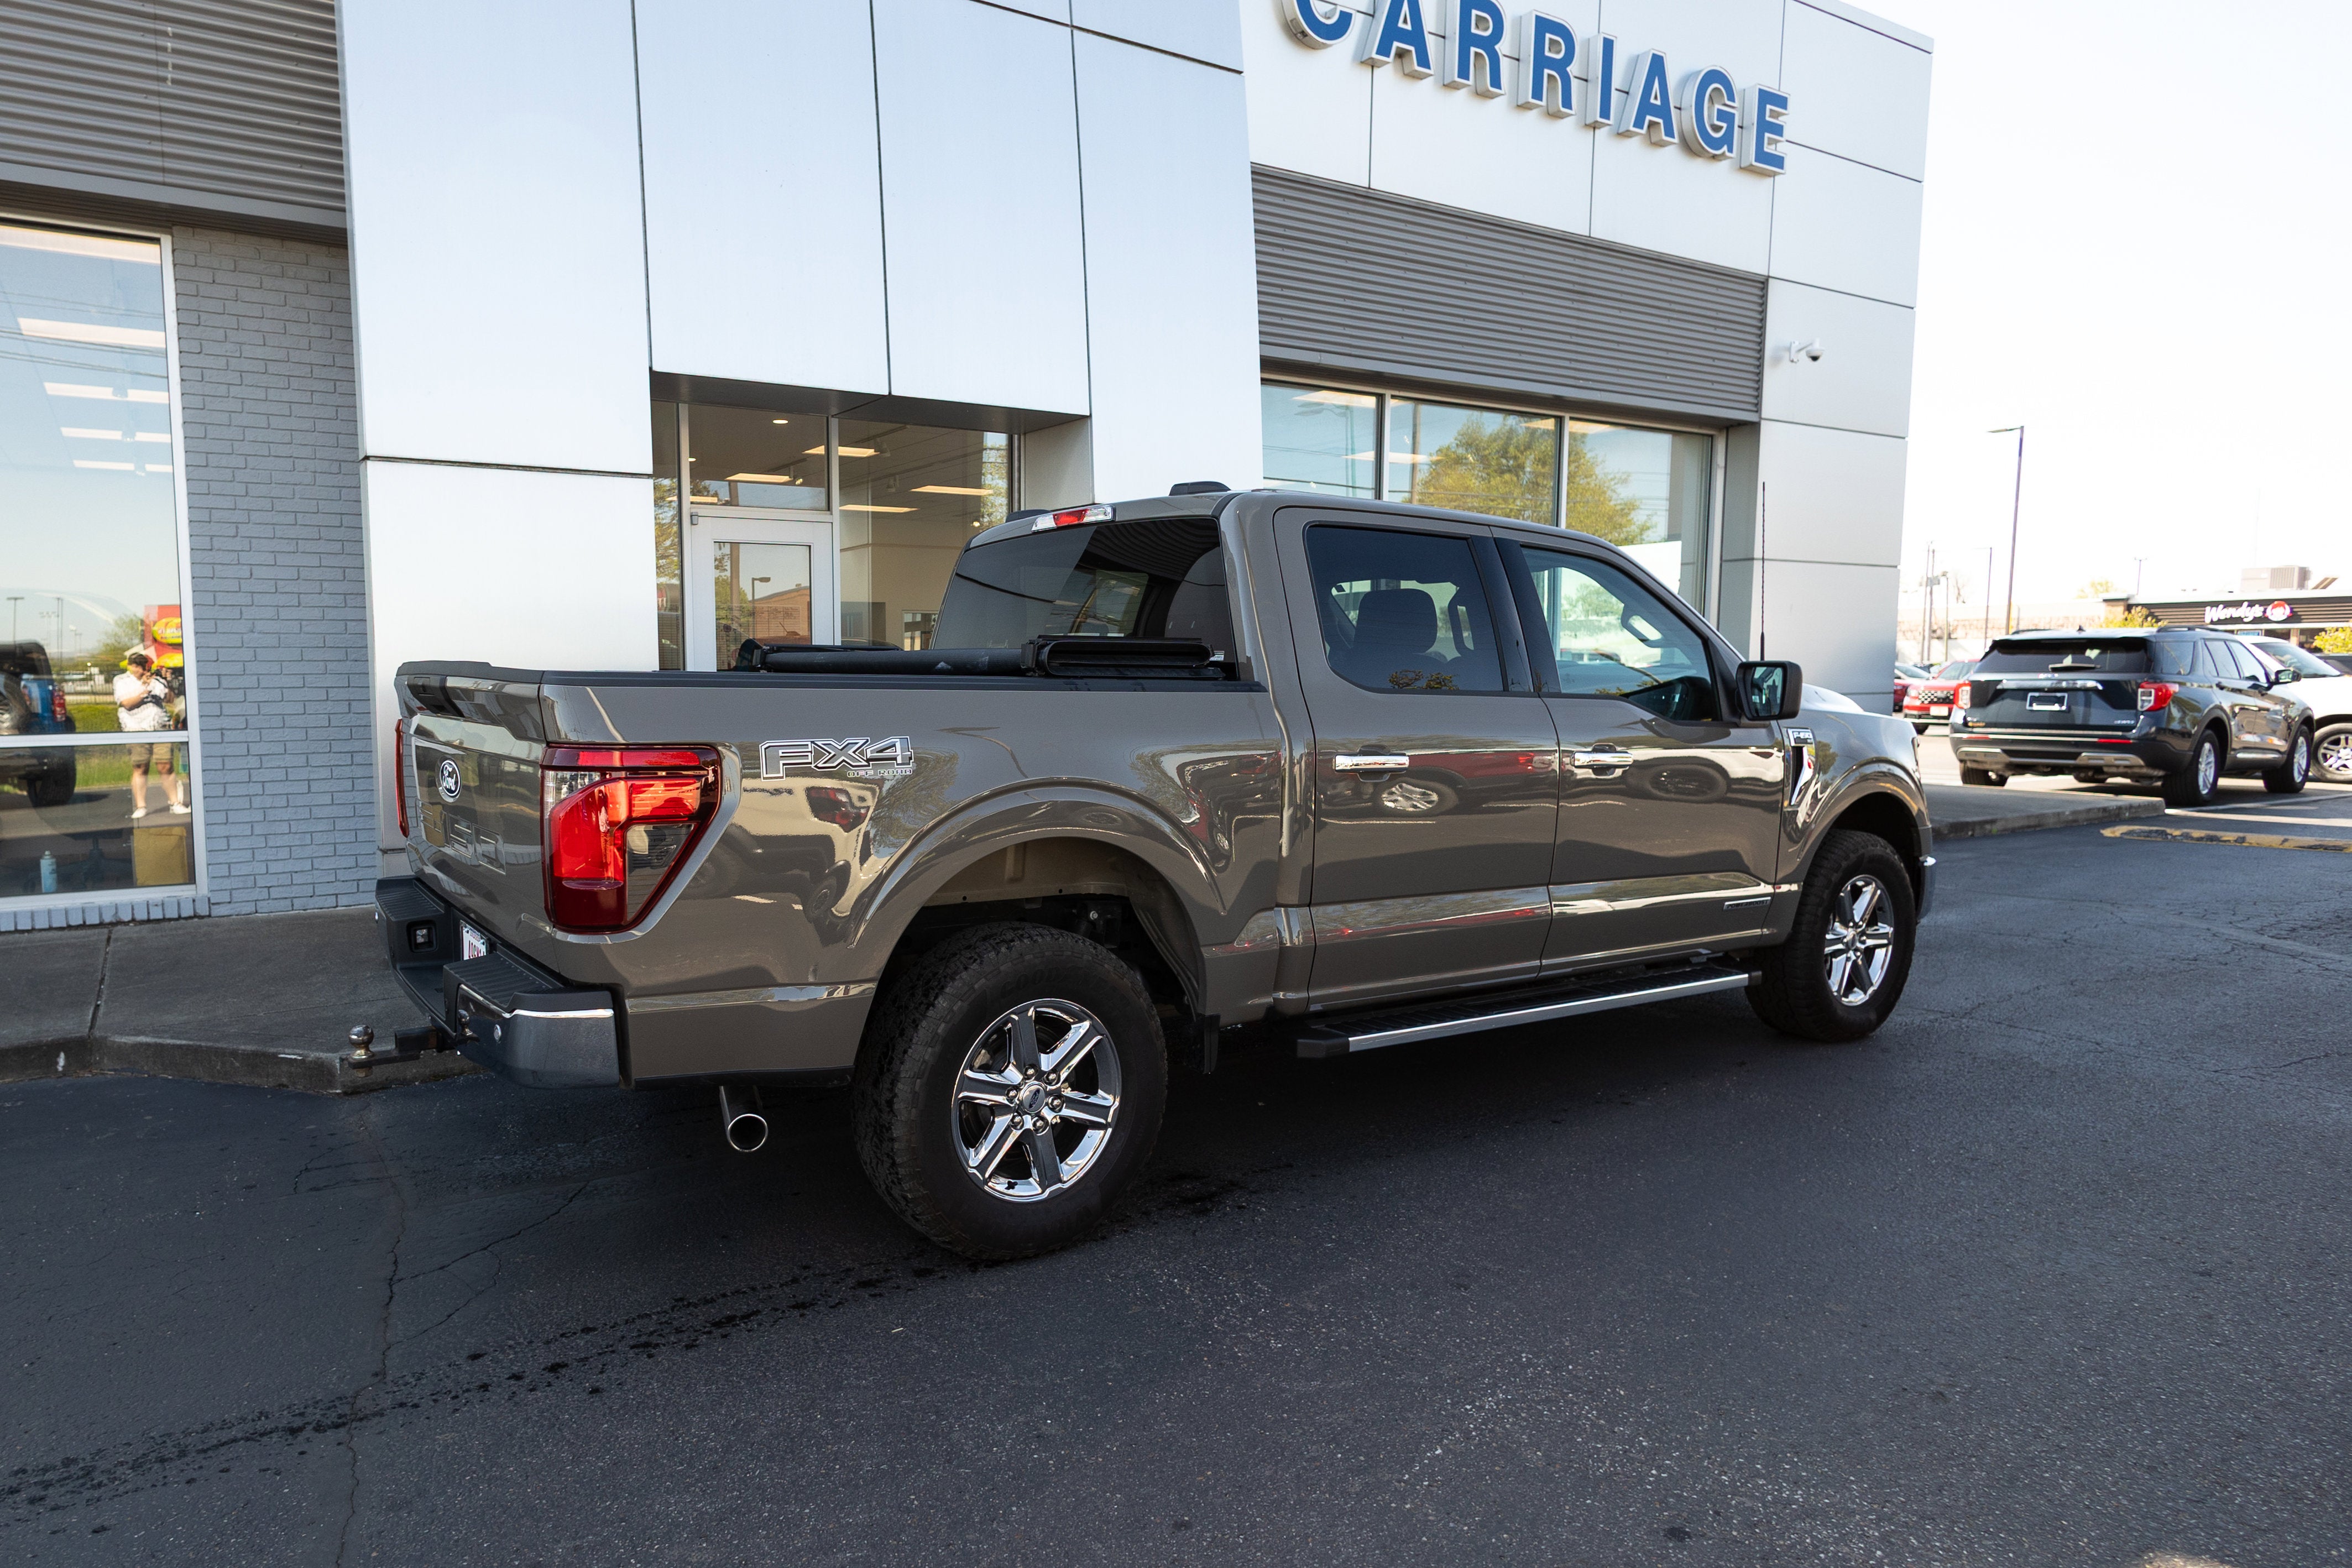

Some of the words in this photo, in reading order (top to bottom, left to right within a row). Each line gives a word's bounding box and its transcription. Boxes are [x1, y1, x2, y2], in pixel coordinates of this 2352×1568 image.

[2204, 601, 2264, 624] Wendy's
[759, 736, 914, 781] FX4
[442, 763, 457, 792] Ford
[877, 768, 912, 776] ROAD
